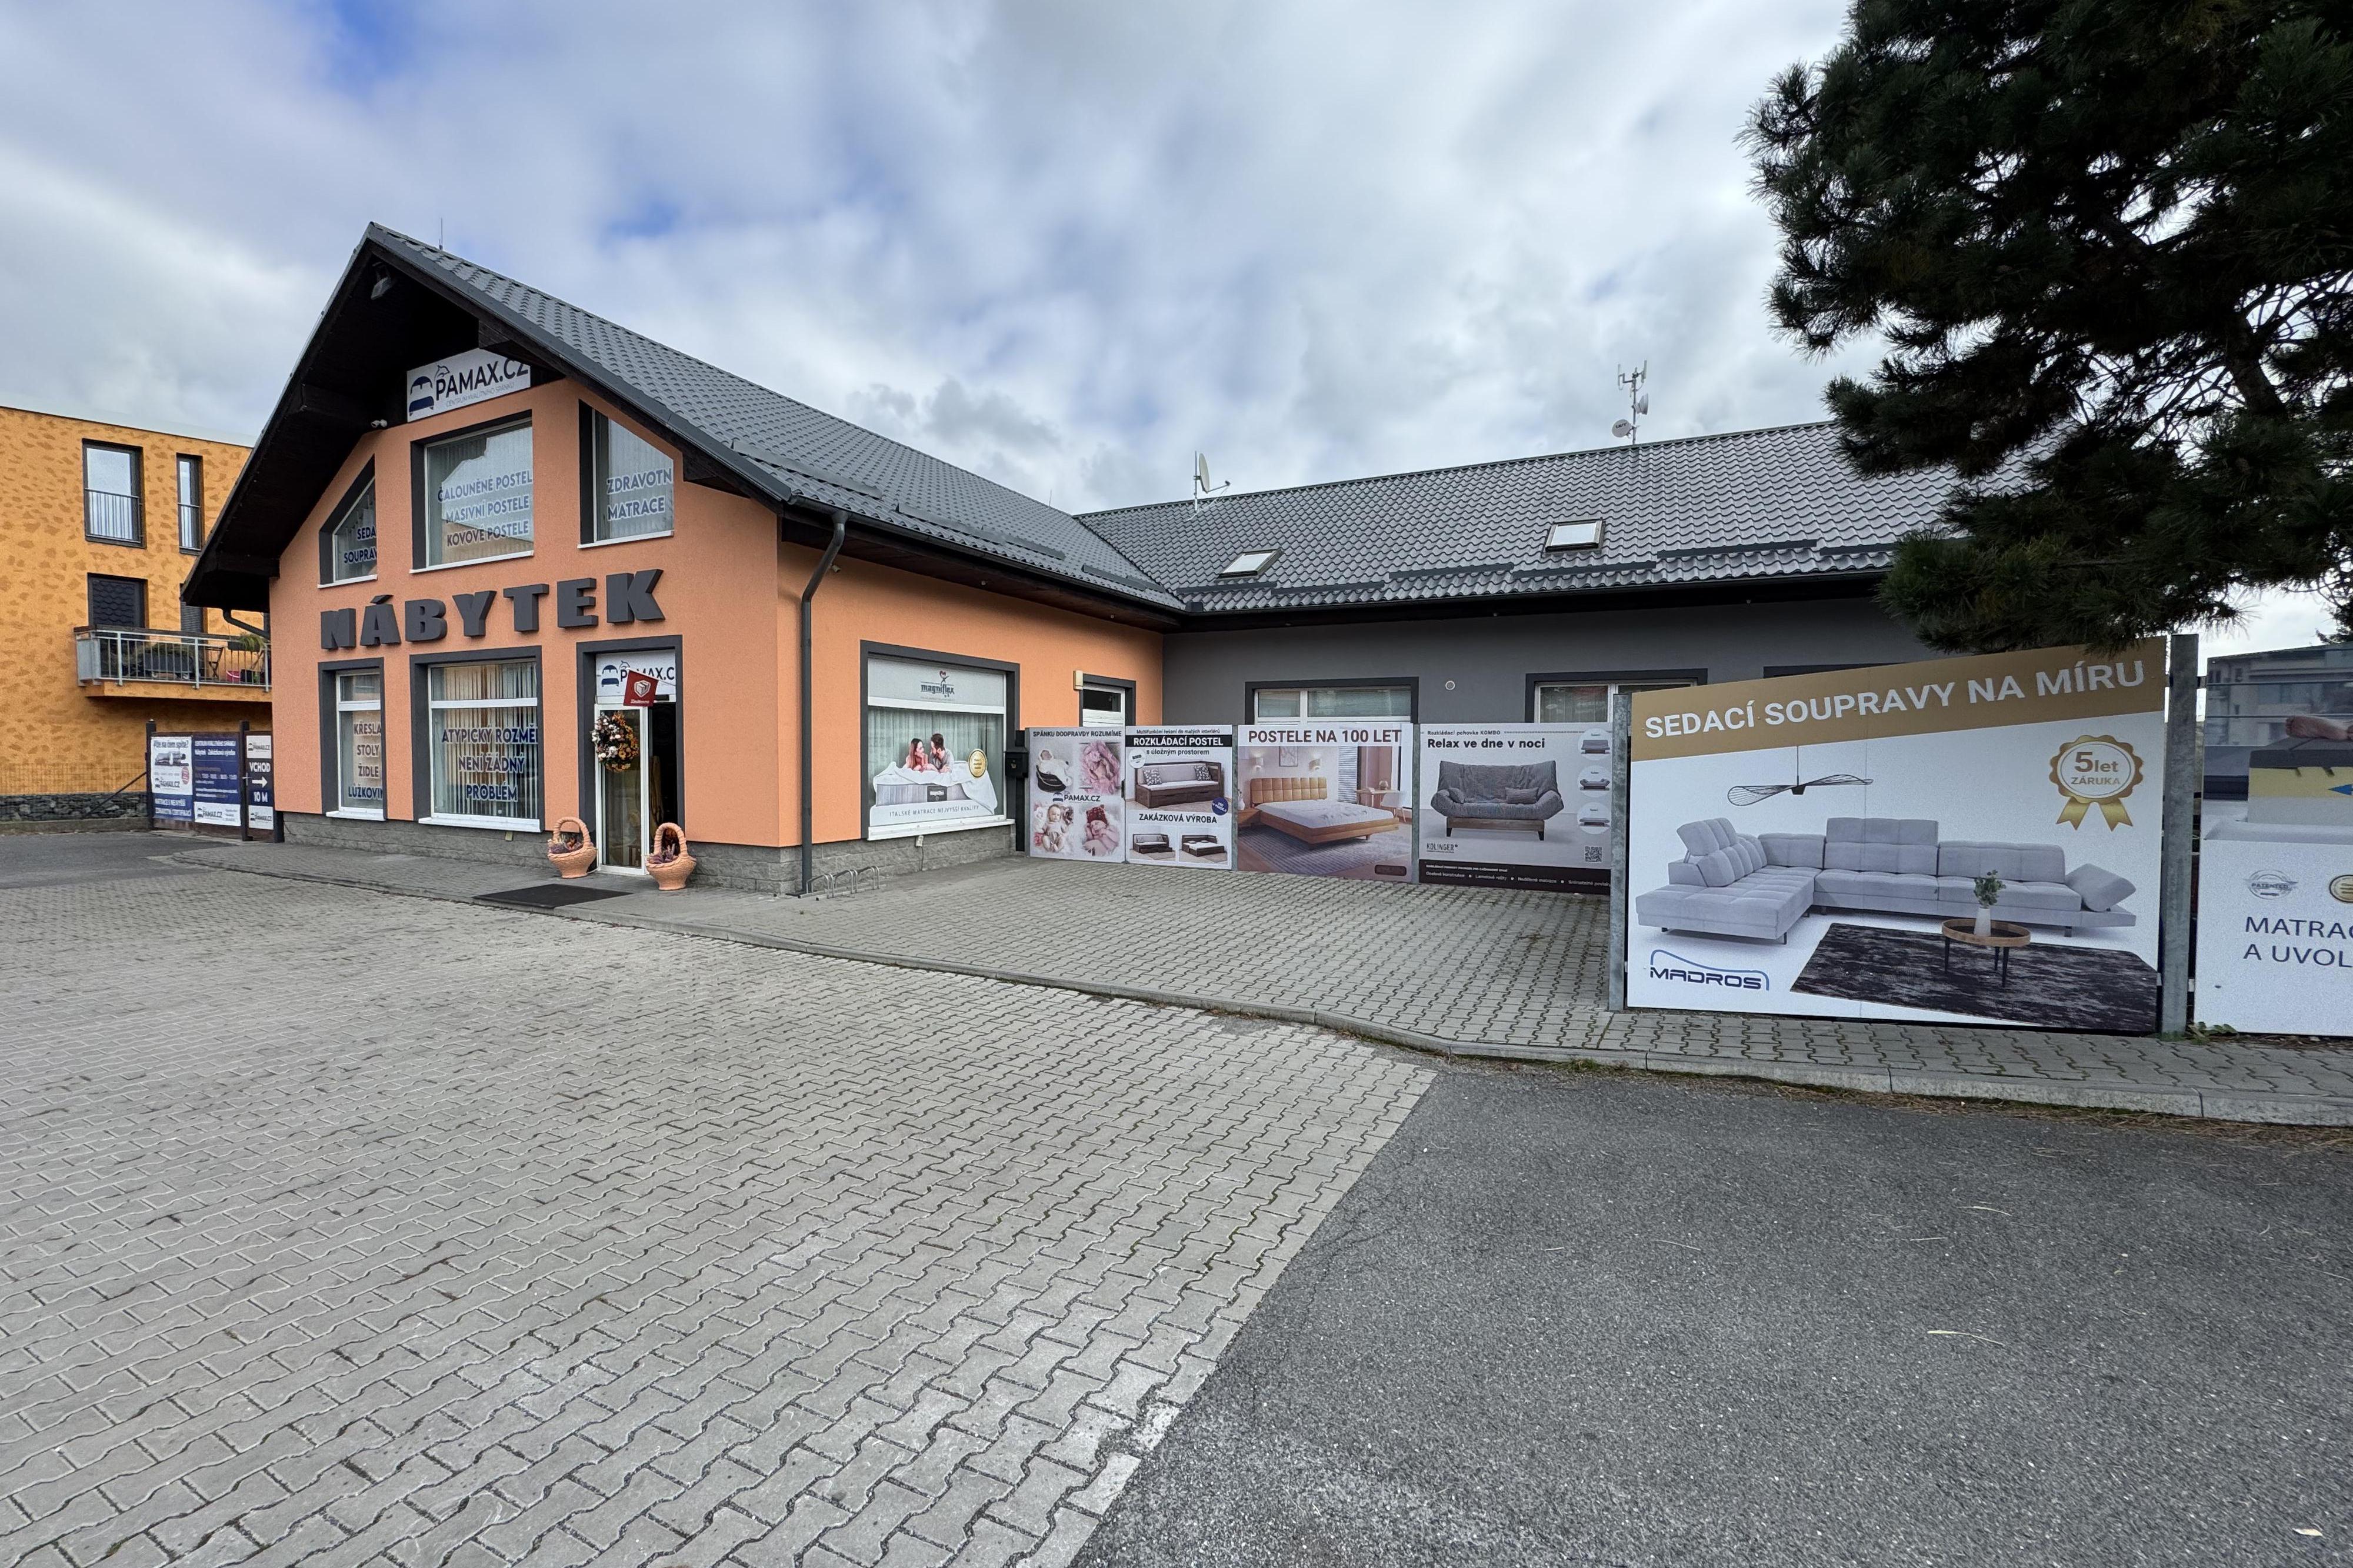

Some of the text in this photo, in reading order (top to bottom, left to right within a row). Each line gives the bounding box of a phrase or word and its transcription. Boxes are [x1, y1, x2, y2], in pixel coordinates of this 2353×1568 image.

[438, 475, 493, 502] ČALOUNĚNÉ
[607, 468, 672, 493] ZDRAVOTN
[446, 495, 529, 523] MASIVNÍ POSTELE
[608, 497, 665, 521] MATRACE
[357, 526, 376, 540] SEDA
[447, 521, 528, 546] KOVOVÉ POSTELE
[321, 569, 665, 649] NÁBYTEK
[921, 683, 955, 695] magniflex
[1645, 660, 2145, 738] SEDACÍ SOUPRAVY NA MÍRU
[354, 720, 381, 735] KŘESLA
[442, 725, 492, 743] ATYPICKÝ
[1133, 736, 1224, 746] ROZKLÁDACÍ POSTEL
[1248, 729, 1402, 743] POSTELE NA 100 LET
[1428, 739, 1459, 748] Relax
[1481, 738, 1504, 748] dne
[1519, 738, 1545, 748] noci
[356, 745, 379, 756] STOLY
[249, 762, 271, 773] VCHOD
[358, 763, 379, 777] ŽIDLE
[458, 752, 525, 773] NENÍ ŽÁDNÝ
[2071, 776, 2120, 785] ZÁRUKA
[254, 792, 268, 803] 10 M
[466, 781, 518, 800] PROBLÉM
[1139, 812, 1217, 823] ZAKÁZKOVÁ VÝROBA
[1427, 843, 1454, 851] KOLINGER
[2245, 916, 2353, 939] MATRA
[2243, 943, 2262, 960] A
[1650, 966, 1762, 990] MADROS
